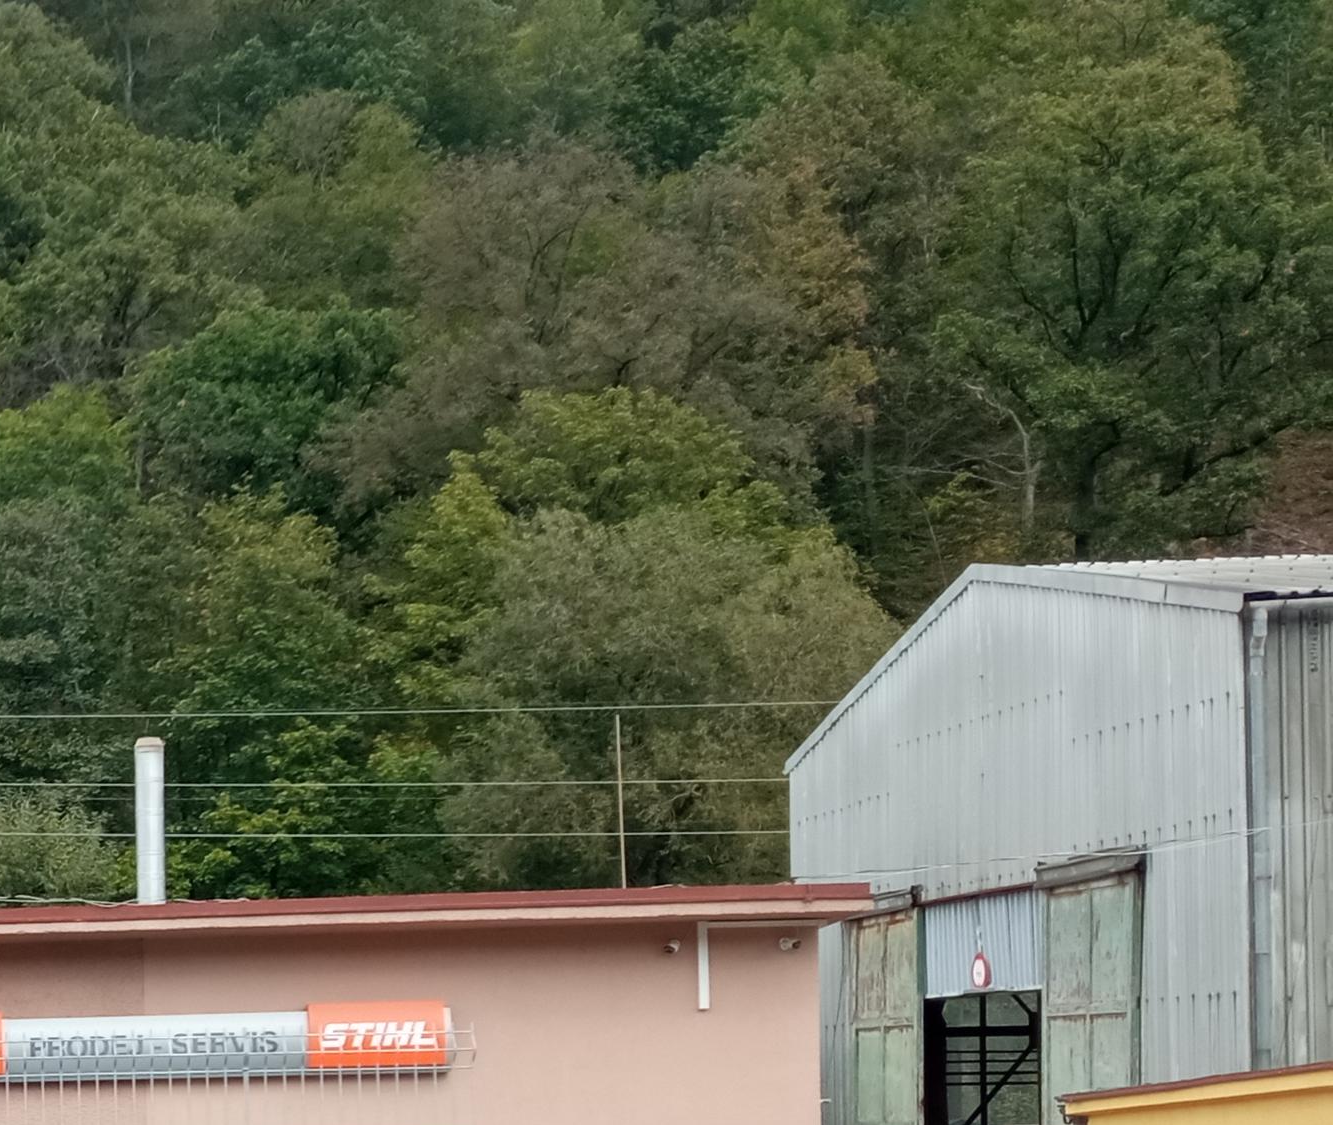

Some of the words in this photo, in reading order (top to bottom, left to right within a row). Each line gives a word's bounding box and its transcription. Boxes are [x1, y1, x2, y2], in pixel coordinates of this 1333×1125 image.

[29, 1034, 144, 1057] PRODEJ
[172, 1031, 279, 1054] SERVIS
[321, 1020, 437, 1049] STIHL
